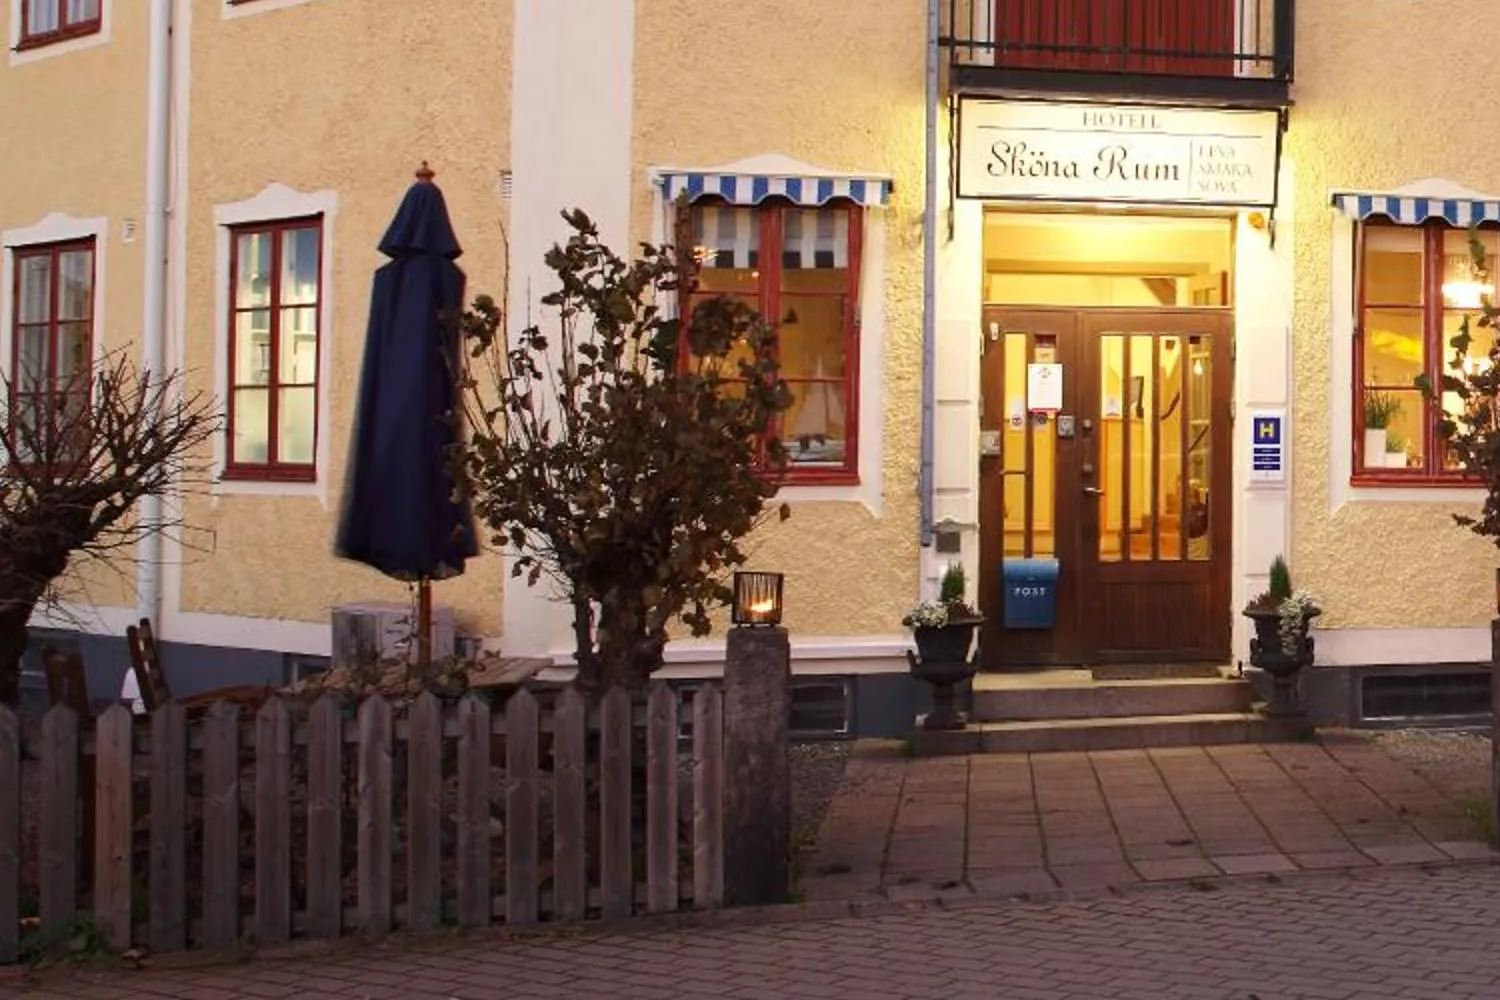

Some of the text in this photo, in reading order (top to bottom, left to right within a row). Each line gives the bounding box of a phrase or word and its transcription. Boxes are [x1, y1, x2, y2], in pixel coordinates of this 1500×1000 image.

[1083, 111, 1161, 129] HOTELL
[986, 140, 1180, 181] Sköna Rum
[1014, 586, 1046, 597] POST
